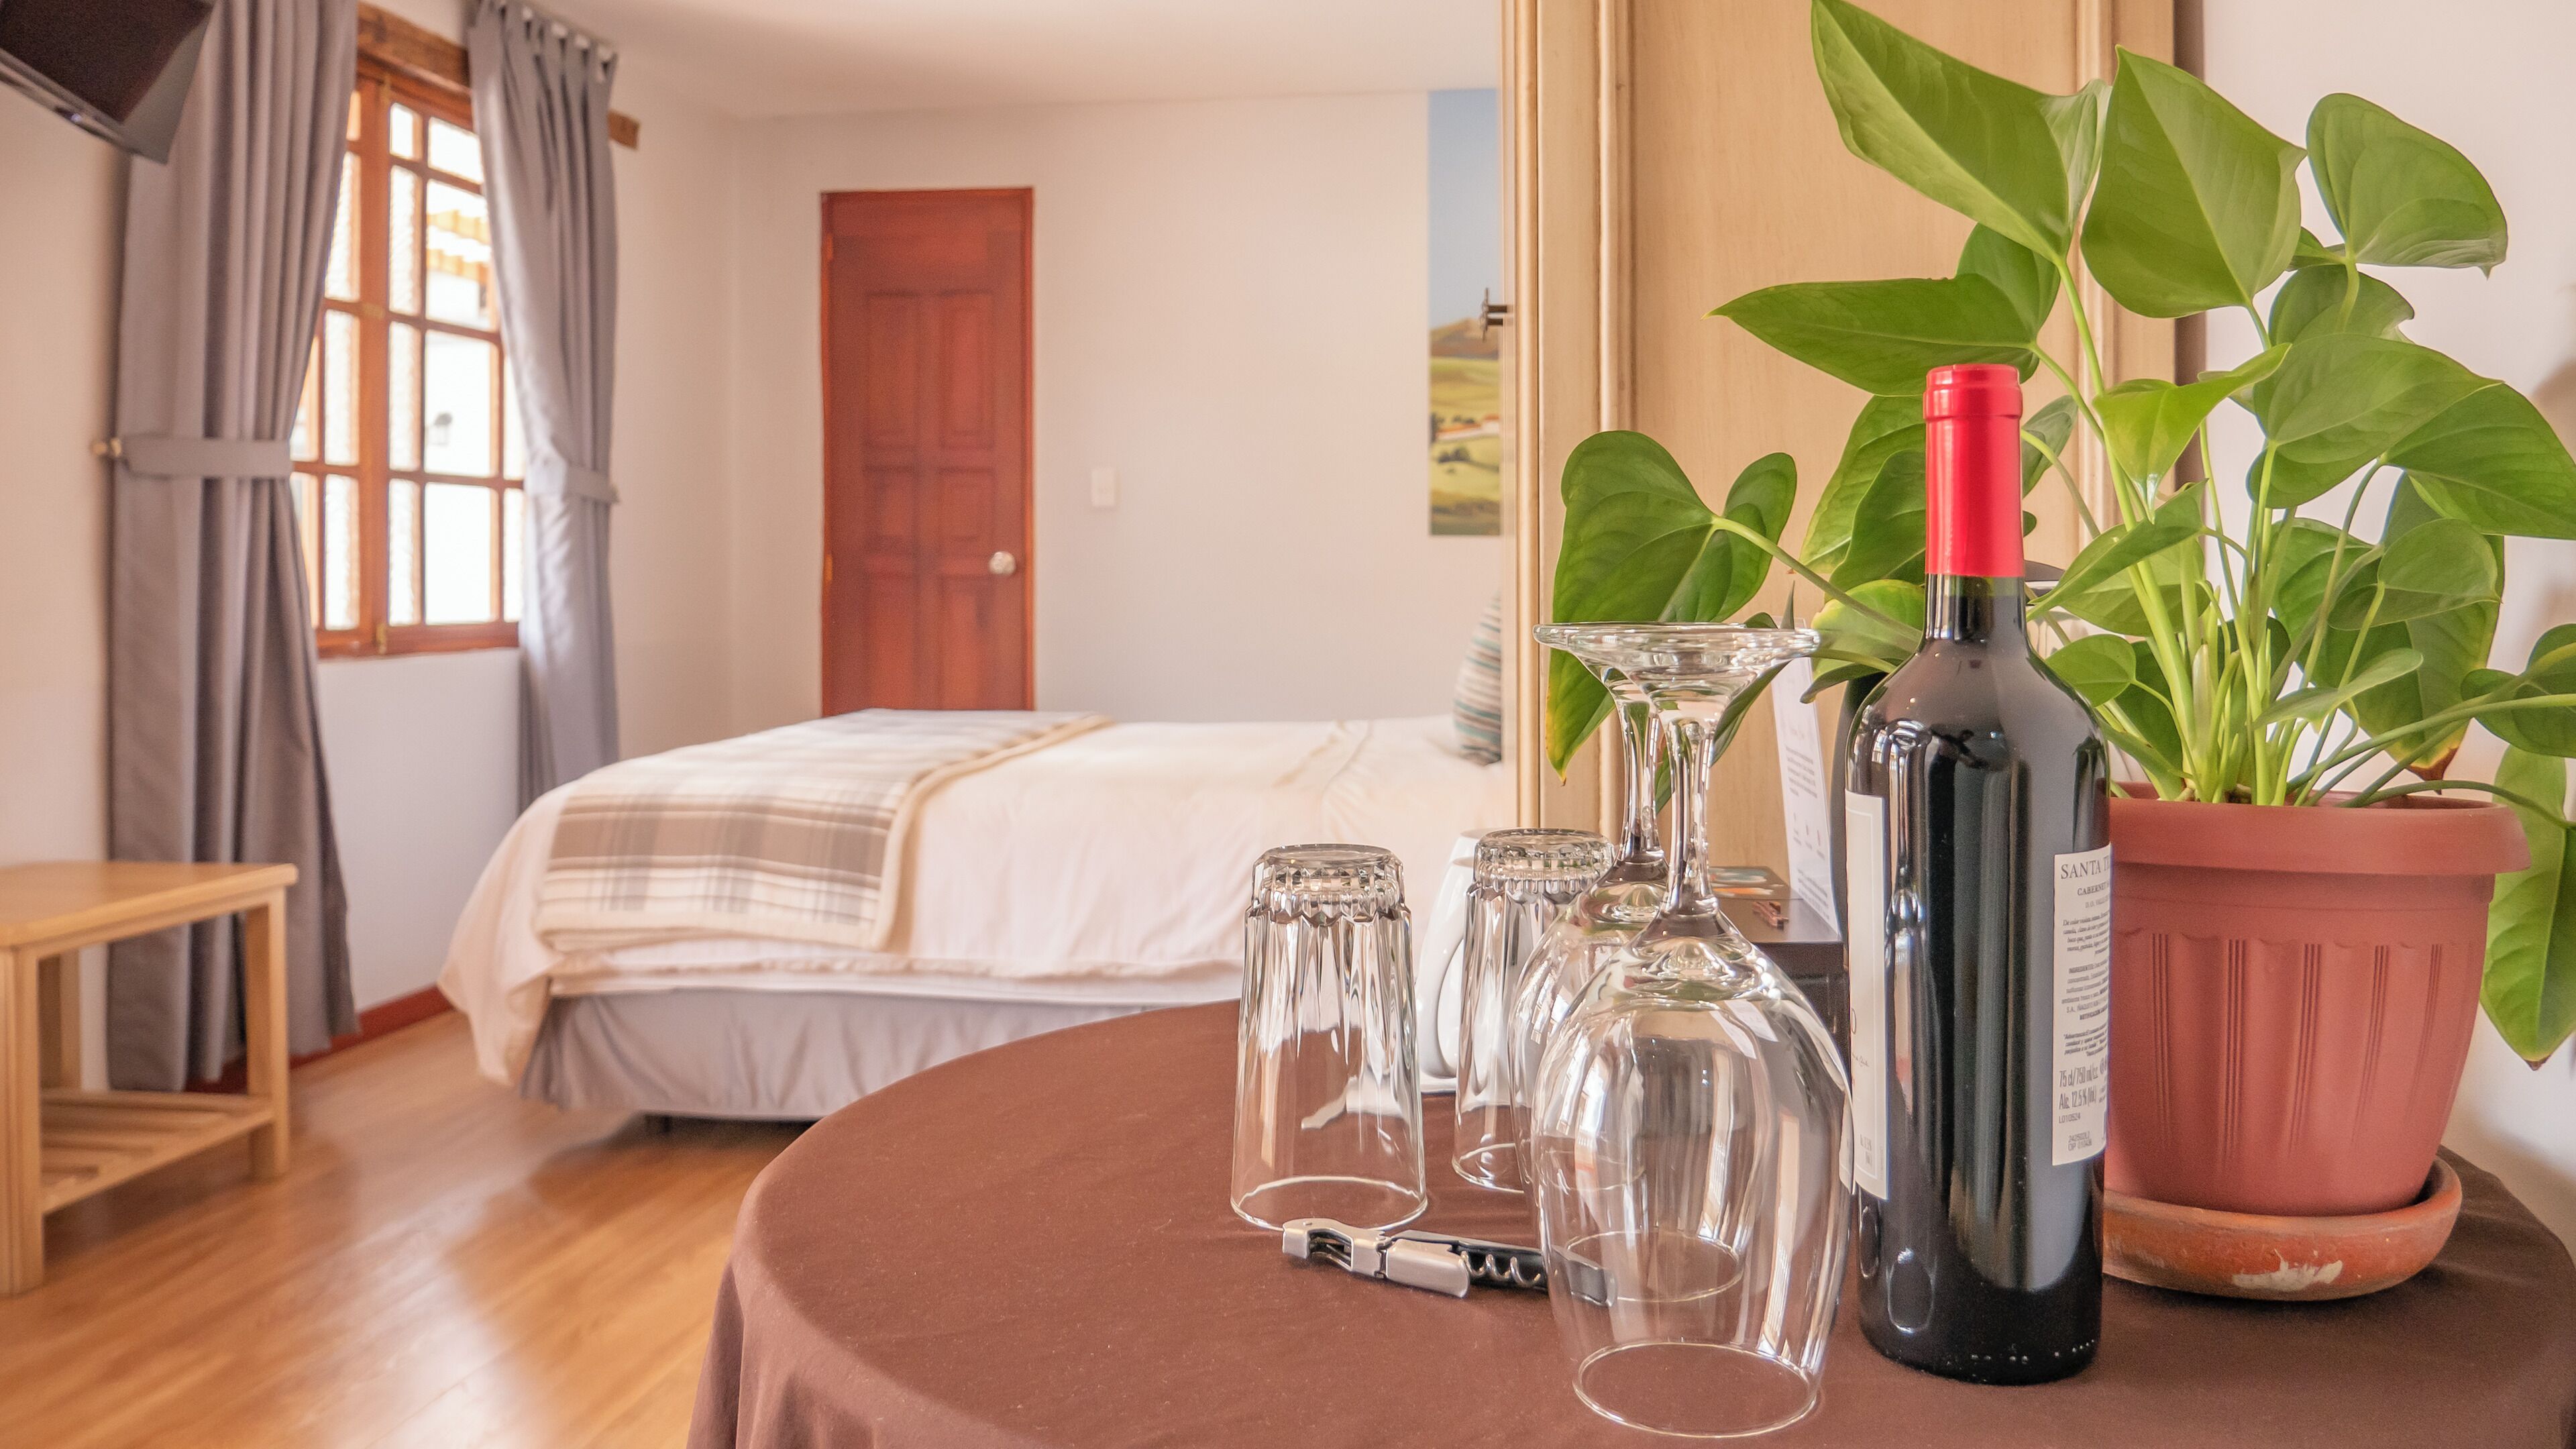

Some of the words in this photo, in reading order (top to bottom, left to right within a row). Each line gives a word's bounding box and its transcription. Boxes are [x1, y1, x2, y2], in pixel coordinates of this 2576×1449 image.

[2061, 860, 2101, 879] SANTA
[2077, 881, 2106, 896] CABERNET
[2059, 1070, 2067, 1087] 75
